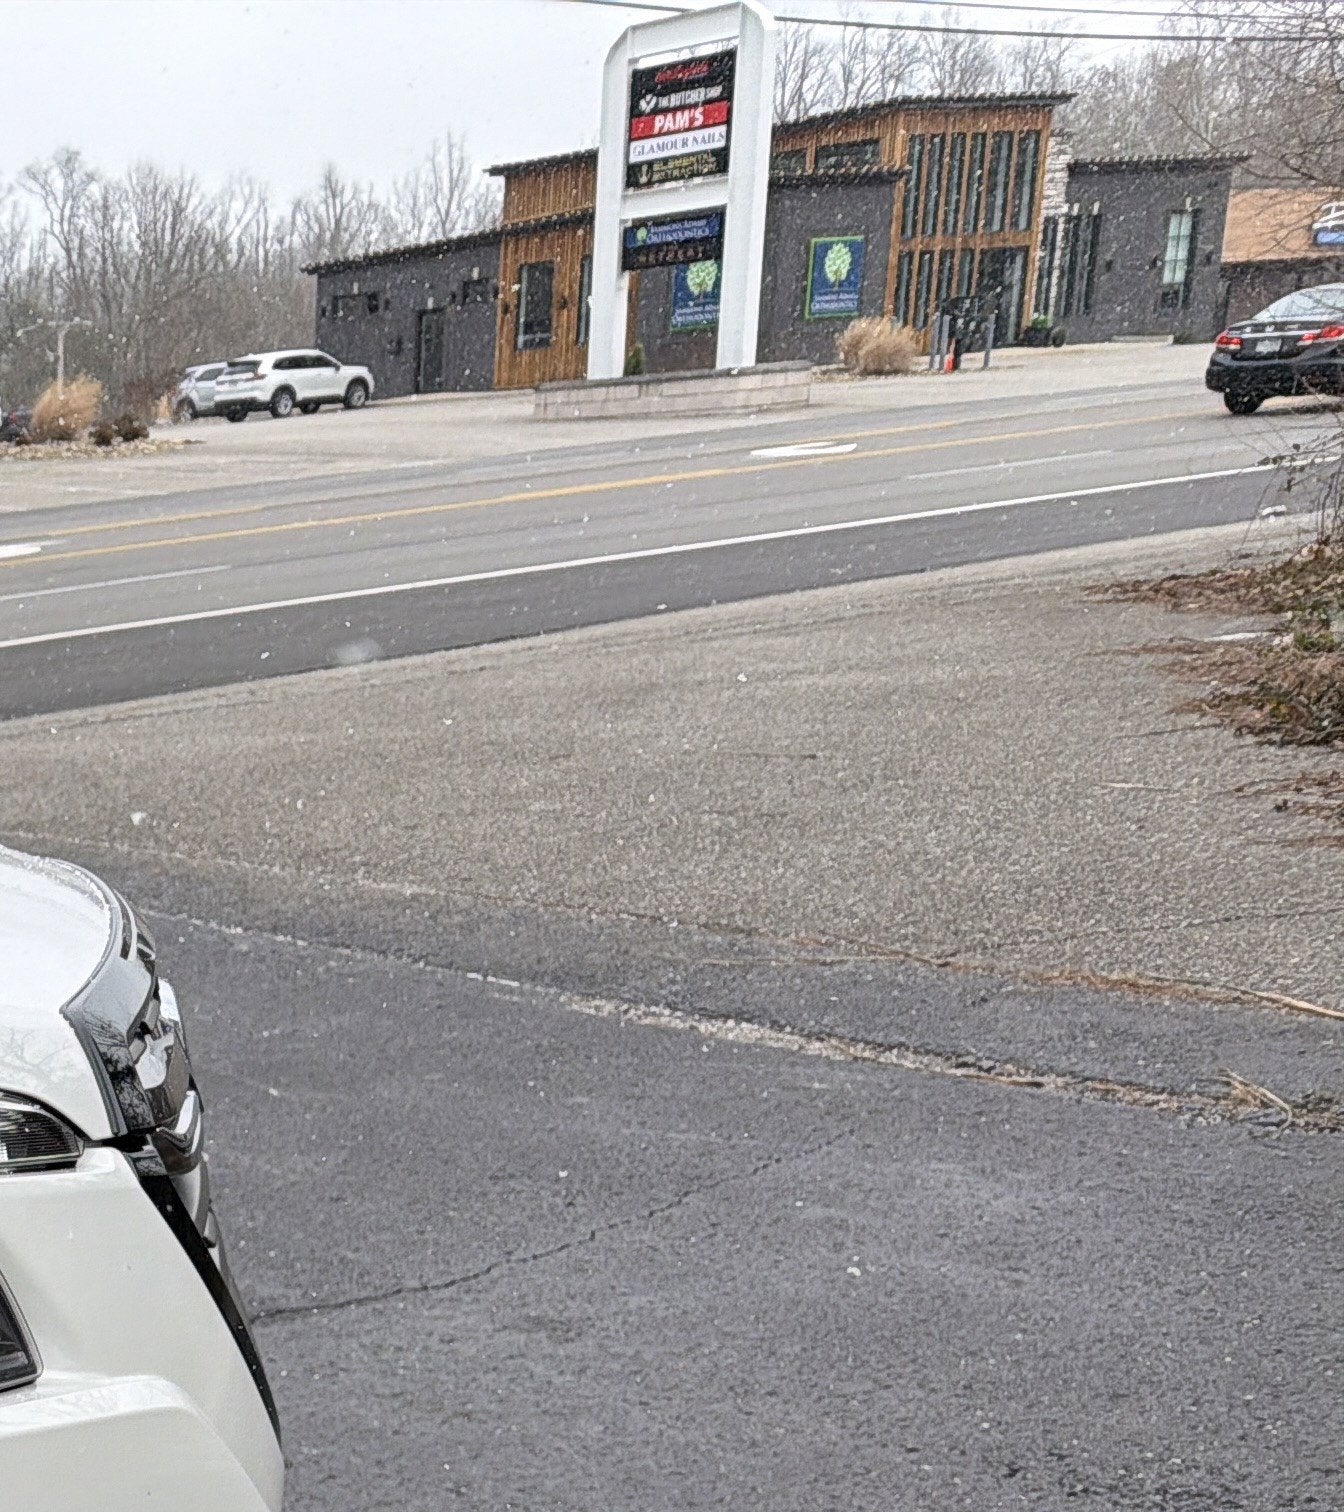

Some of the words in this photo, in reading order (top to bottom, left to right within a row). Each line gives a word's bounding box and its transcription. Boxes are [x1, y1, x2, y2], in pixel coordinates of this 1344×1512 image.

[670, 87, 706, 107] BUTCHER
[653, 106, 704, 135] PAM'S
[632, 136, 689, 157] GLAMOUR
[692, 131, 725, 146] NAILS
